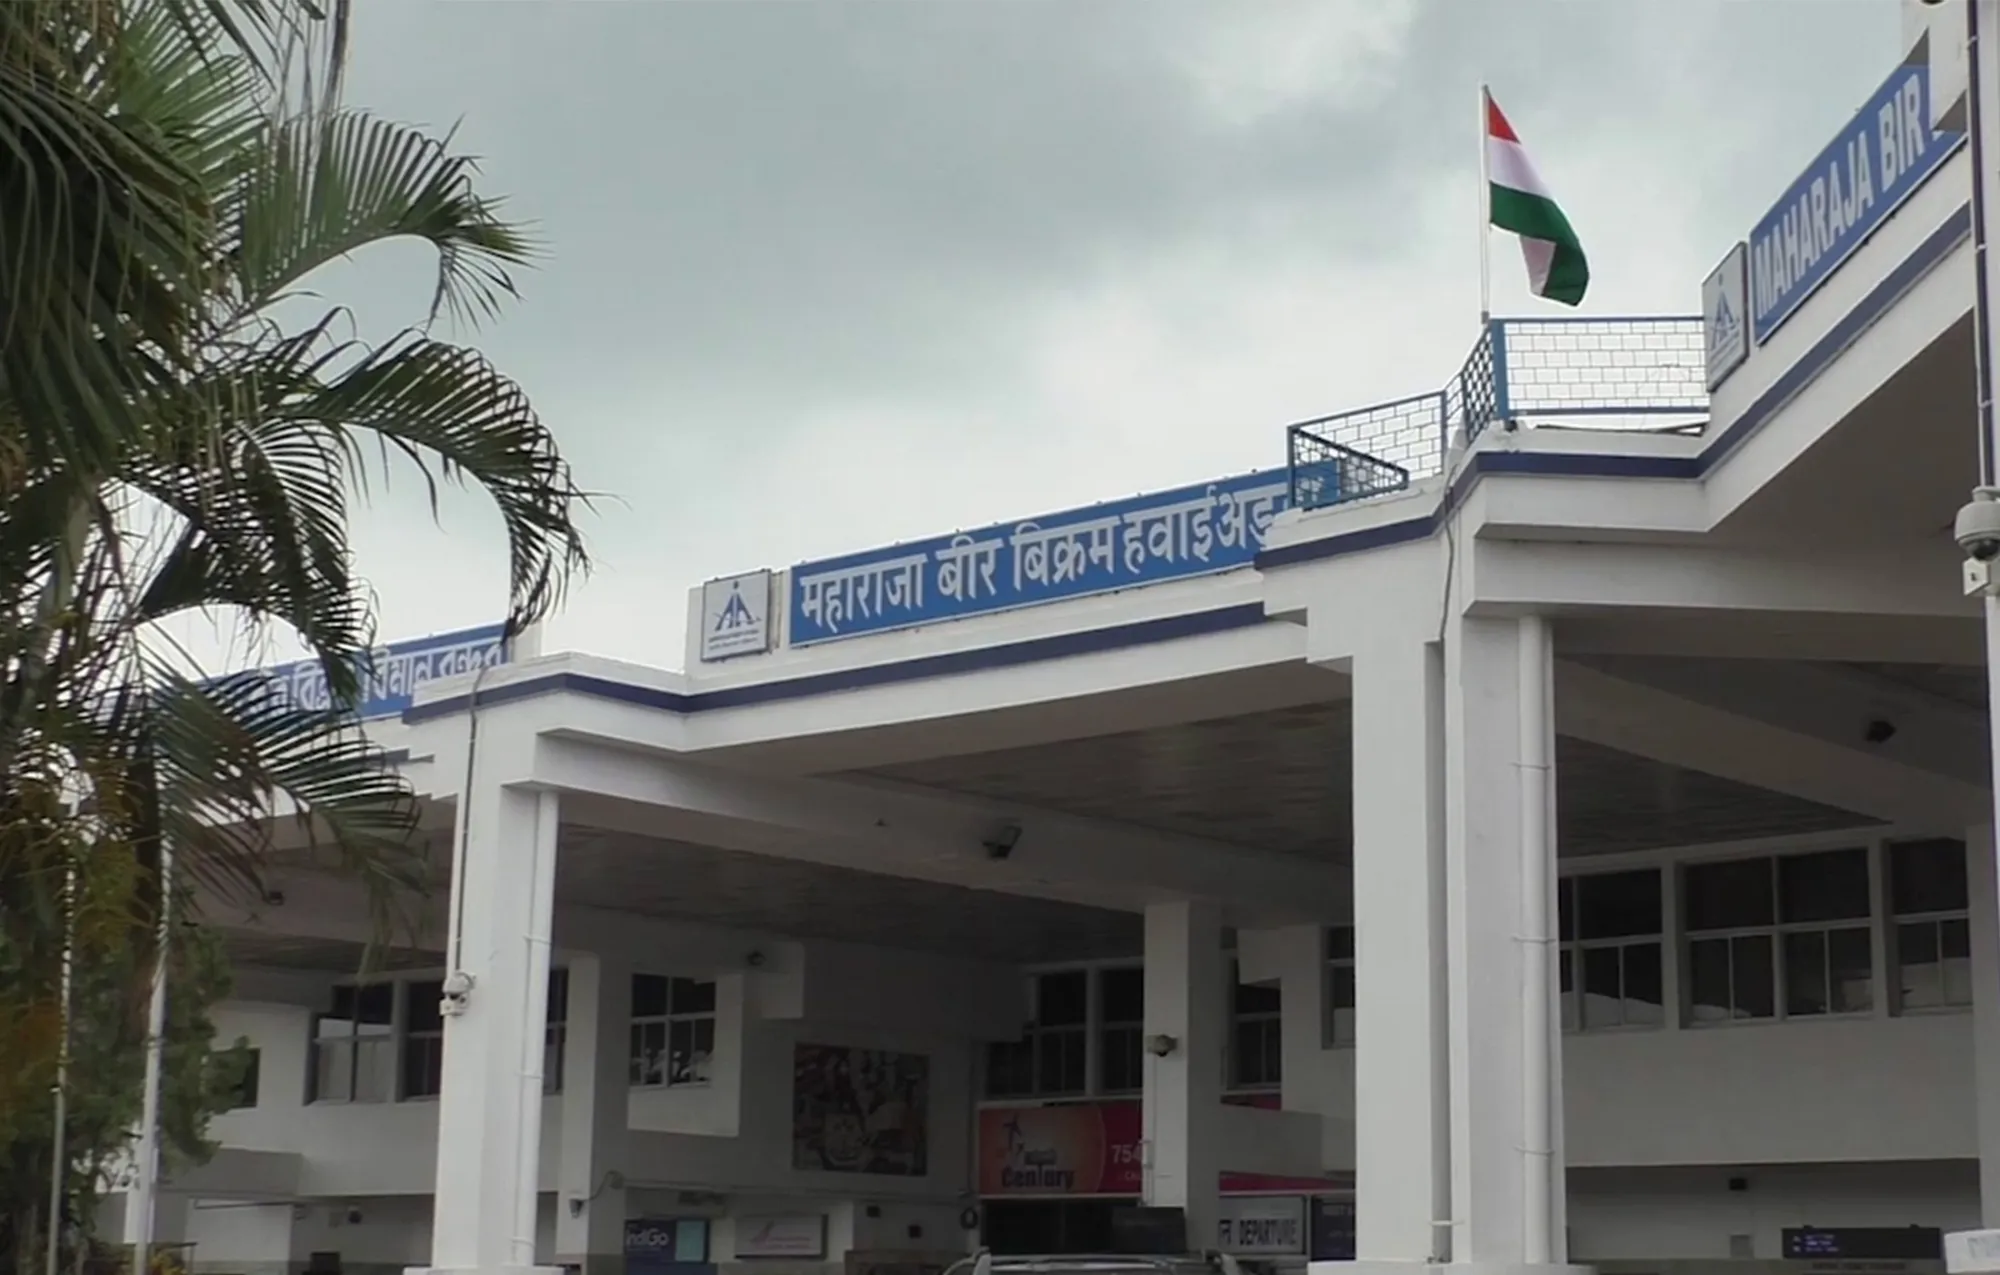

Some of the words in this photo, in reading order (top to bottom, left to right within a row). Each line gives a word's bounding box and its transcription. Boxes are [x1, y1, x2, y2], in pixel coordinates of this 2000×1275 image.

[1754, 130, 1875, 321] MAHARAJA
[1877, 73, 1925, 194] BIR
[798, 553, 929, 634] महाराजा
[937, 535, 1004, 603] बीर
[1010, 520, 1120, 591] बिक्रम
[1239, 1219, 1297, 1246] DEPARTURE
